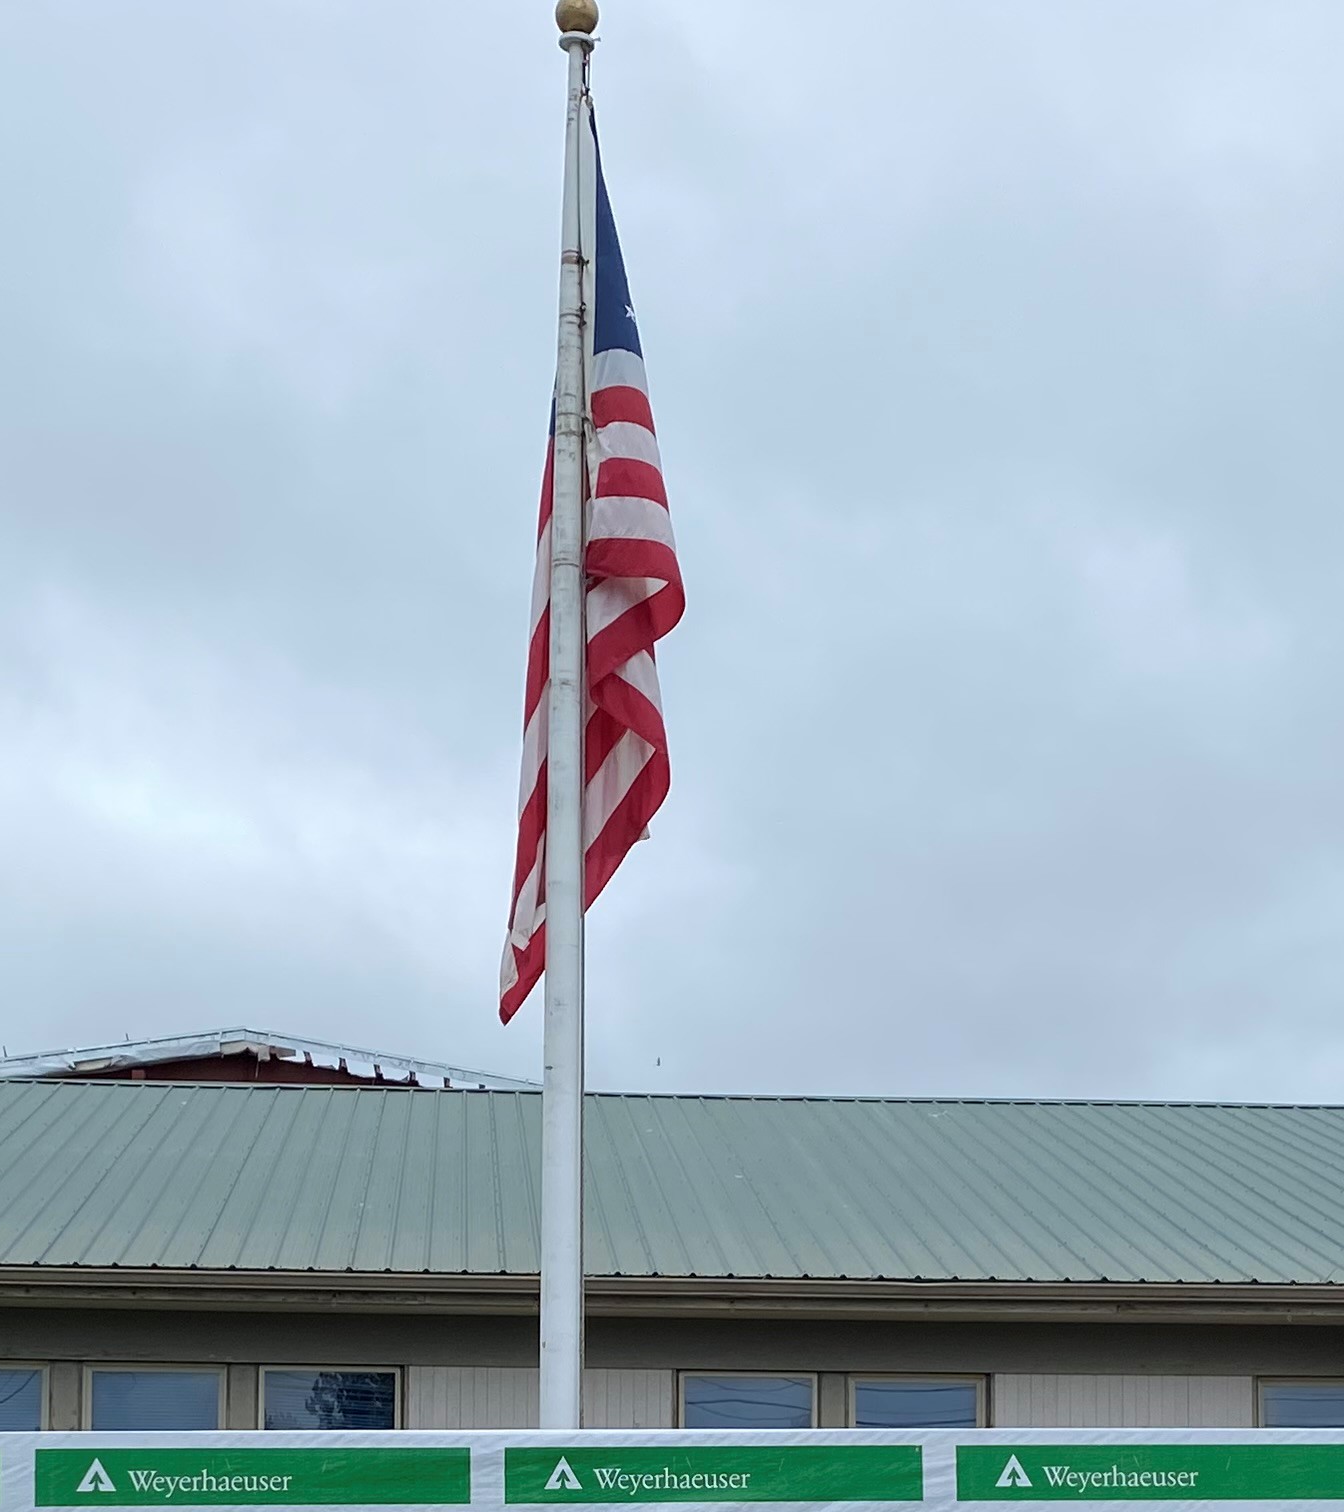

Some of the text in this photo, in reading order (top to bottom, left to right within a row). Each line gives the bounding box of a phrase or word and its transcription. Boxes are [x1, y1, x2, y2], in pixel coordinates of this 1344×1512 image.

[128, 1469, 292, 1498] Weyerhaeuser
[593, 1467, 750, 1496] Weyerhaeuser
[1042, 1465, 1199, 1493] Weyerhaeuser
